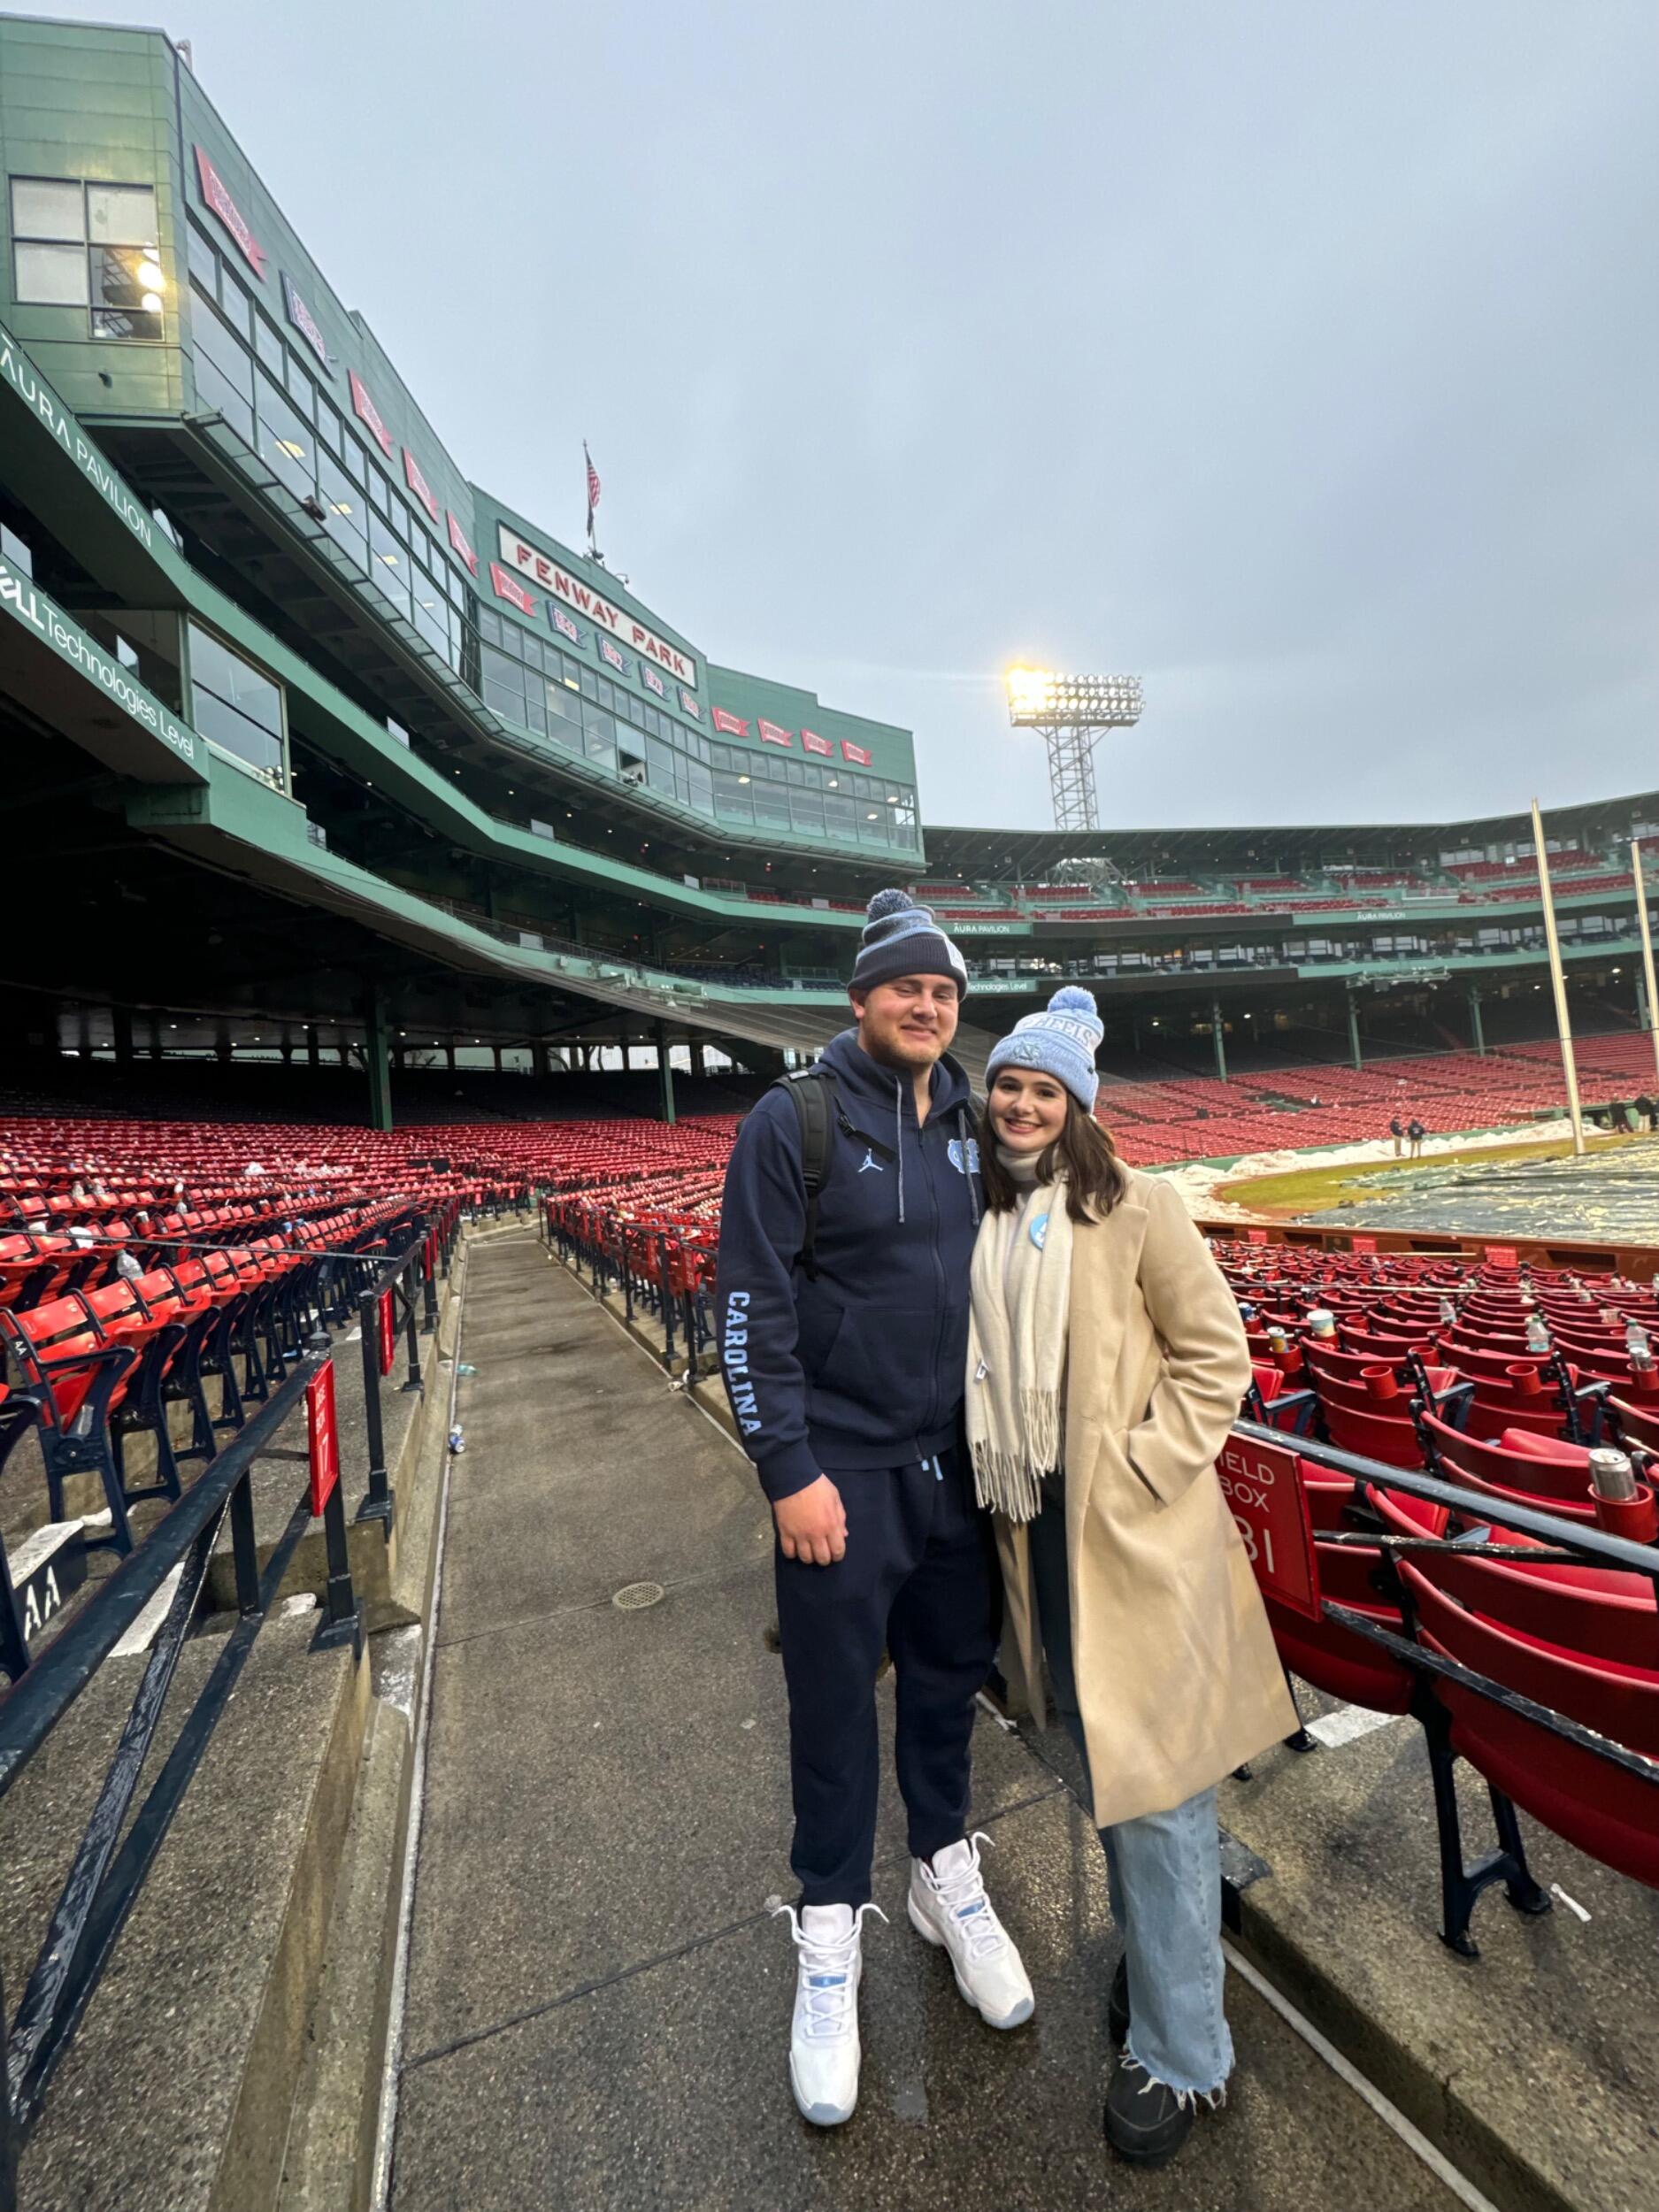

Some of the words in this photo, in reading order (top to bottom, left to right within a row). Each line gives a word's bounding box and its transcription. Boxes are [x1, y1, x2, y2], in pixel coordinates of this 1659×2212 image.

[77, 438, 151, 547] PAVILION
[0, 565, 45, 630] ELL
[42, 603, 157, 727] Technologies
[159, 710, 195, 759] Level
[517, 544, 618, 628] FENWAY
[632, 625, 686, 676] PARK
[724, 1291, 762, 1437] CAROLINA
[1219, 1451, 1275, 1486] IELD
[1219, 1475, 1271, 1513] BOX
[24, 1564, 61, 1642] AA
